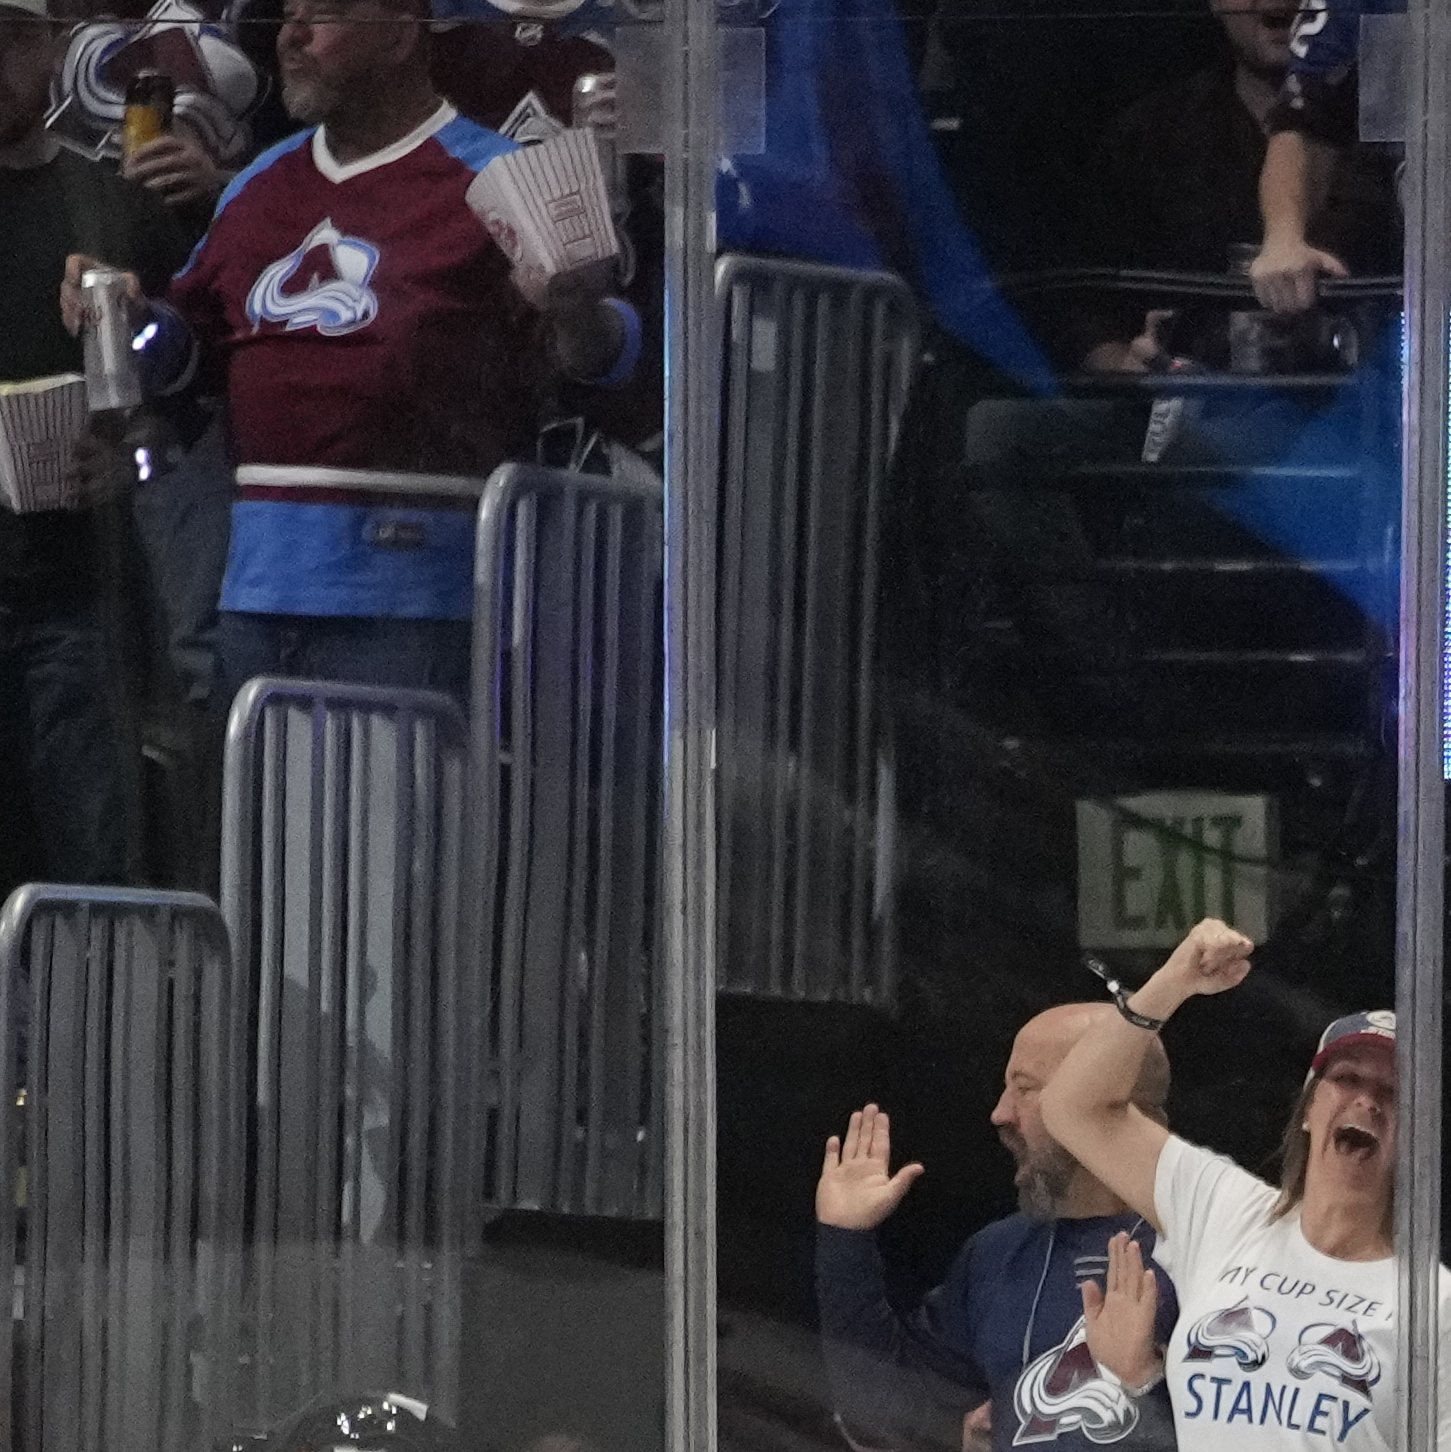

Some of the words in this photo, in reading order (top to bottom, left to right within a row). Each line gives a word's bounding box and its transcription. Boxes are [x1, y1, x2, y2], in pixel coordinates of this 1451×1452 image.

[1112, 816, 1243, 931] EXIT
[1259, 1272, 1316, 1299] CUP
[1318, 1289, 1383, 1318] SIZE
[1184, 1372, 1373, 1443] STANLEY
